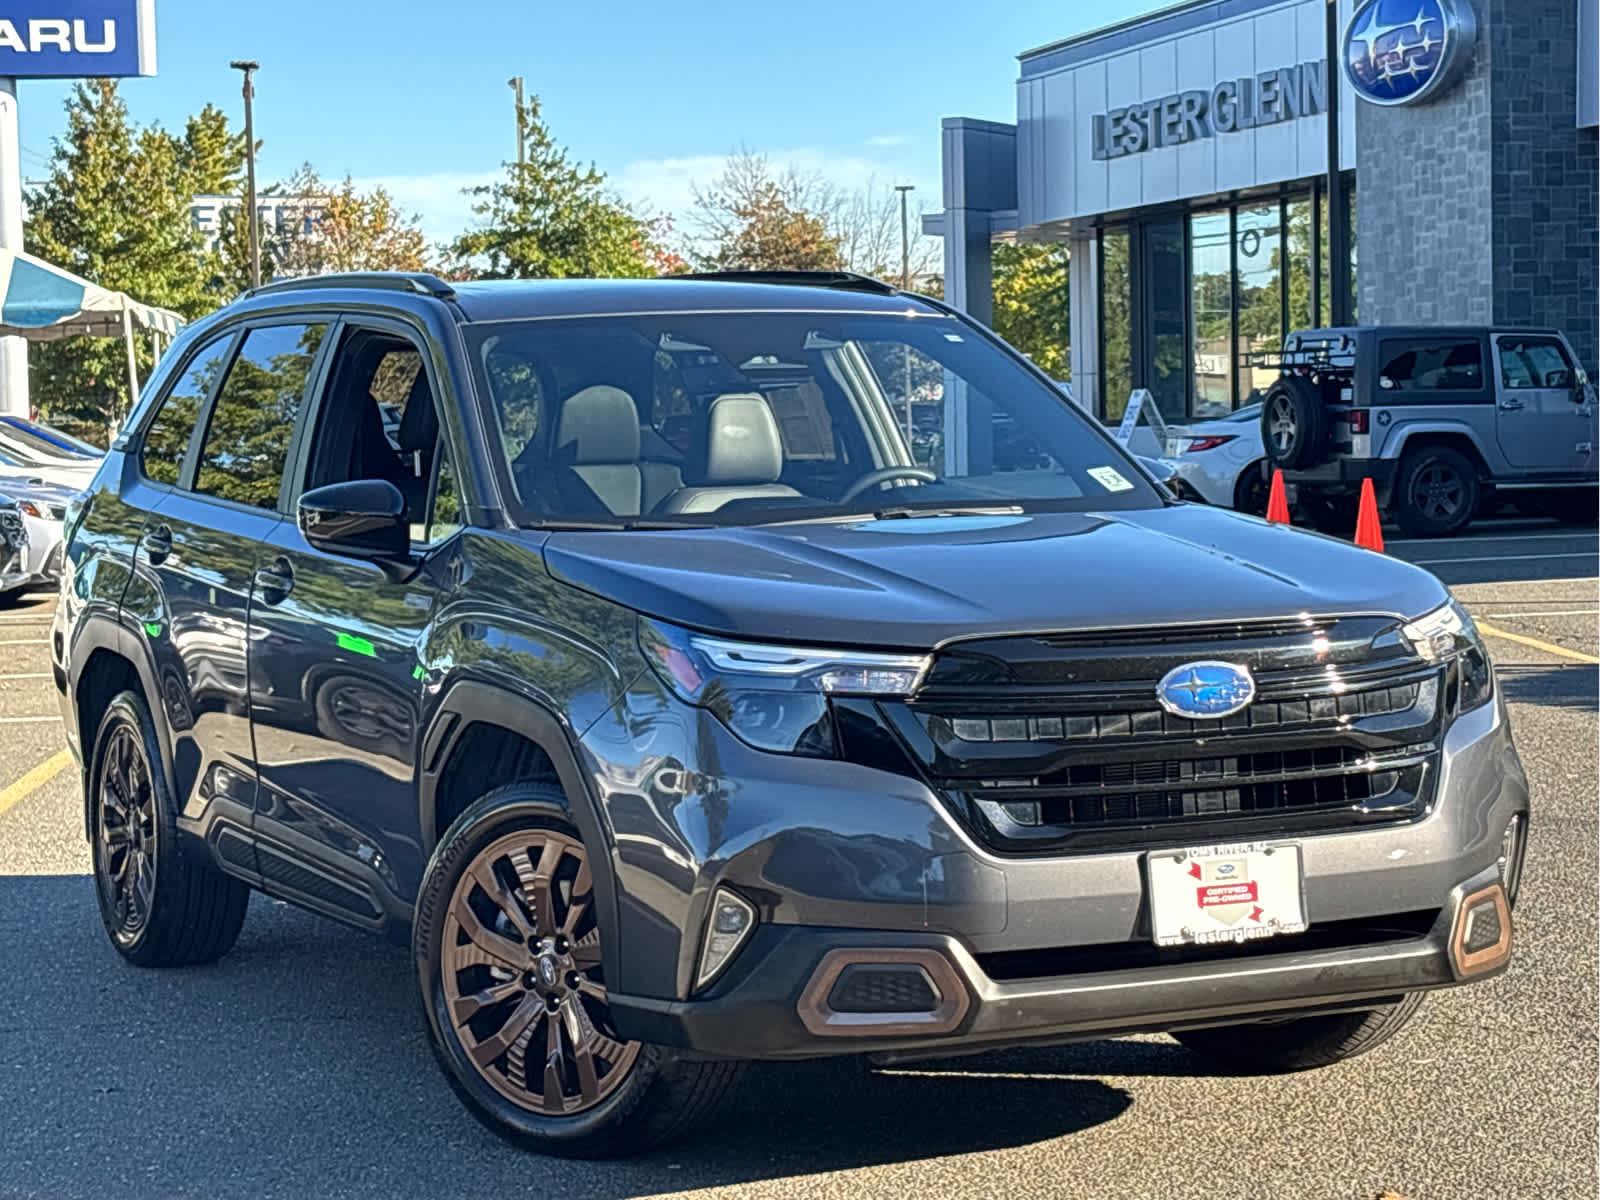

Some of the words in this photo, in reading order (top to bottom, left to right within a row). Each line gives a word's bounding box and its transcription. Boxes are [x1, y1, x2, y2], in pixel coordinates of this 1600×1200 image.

[1092, 89, 1213, 160] LESTER
[1211, 59, 1328, 133] GLENN
[1206, 886, 1248, 896] CERTIFIED
[1202, 893, 1253, 904] PRE-OWNED
